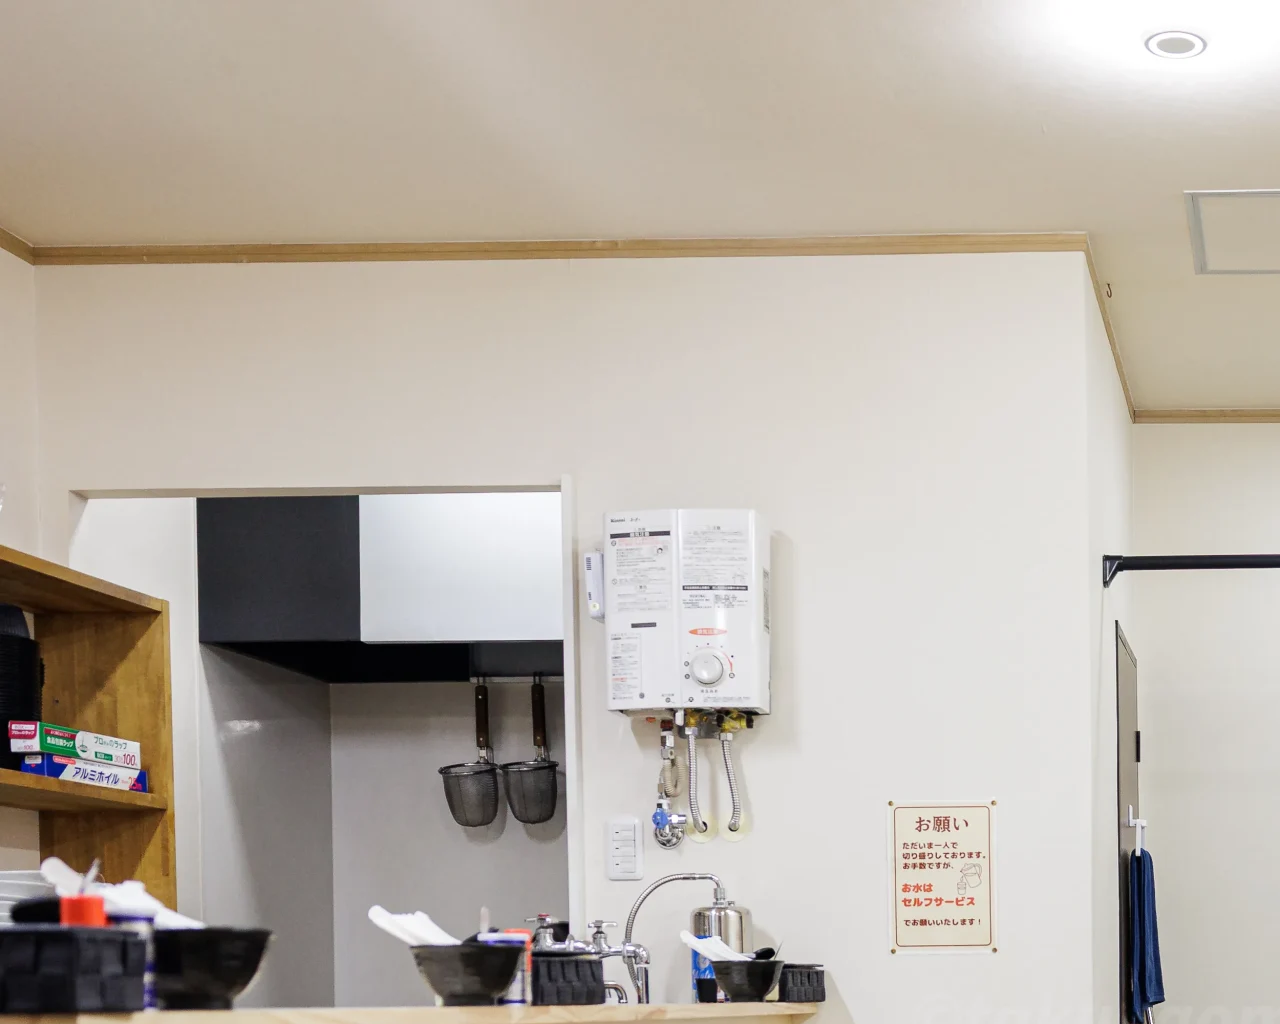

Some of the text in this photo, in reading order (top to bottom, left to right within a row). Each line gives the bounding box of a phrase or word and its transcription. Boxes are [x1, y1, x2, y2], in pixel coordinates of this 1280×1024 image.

[72, 766, 120, 785] アルミホイル
[915, 815, 969, 833] お願い
[902, 841, 958, 850] ただいま一人で
[902, 851, 986, 860] 切り盛りしております。
[902, 862, 955, 870] お手数ですが、
[901, 883, 933, 893] お水は
[901, 897, 976, 907] セルフサービス
[904, 918, 981, 927] でお願いいたします！
